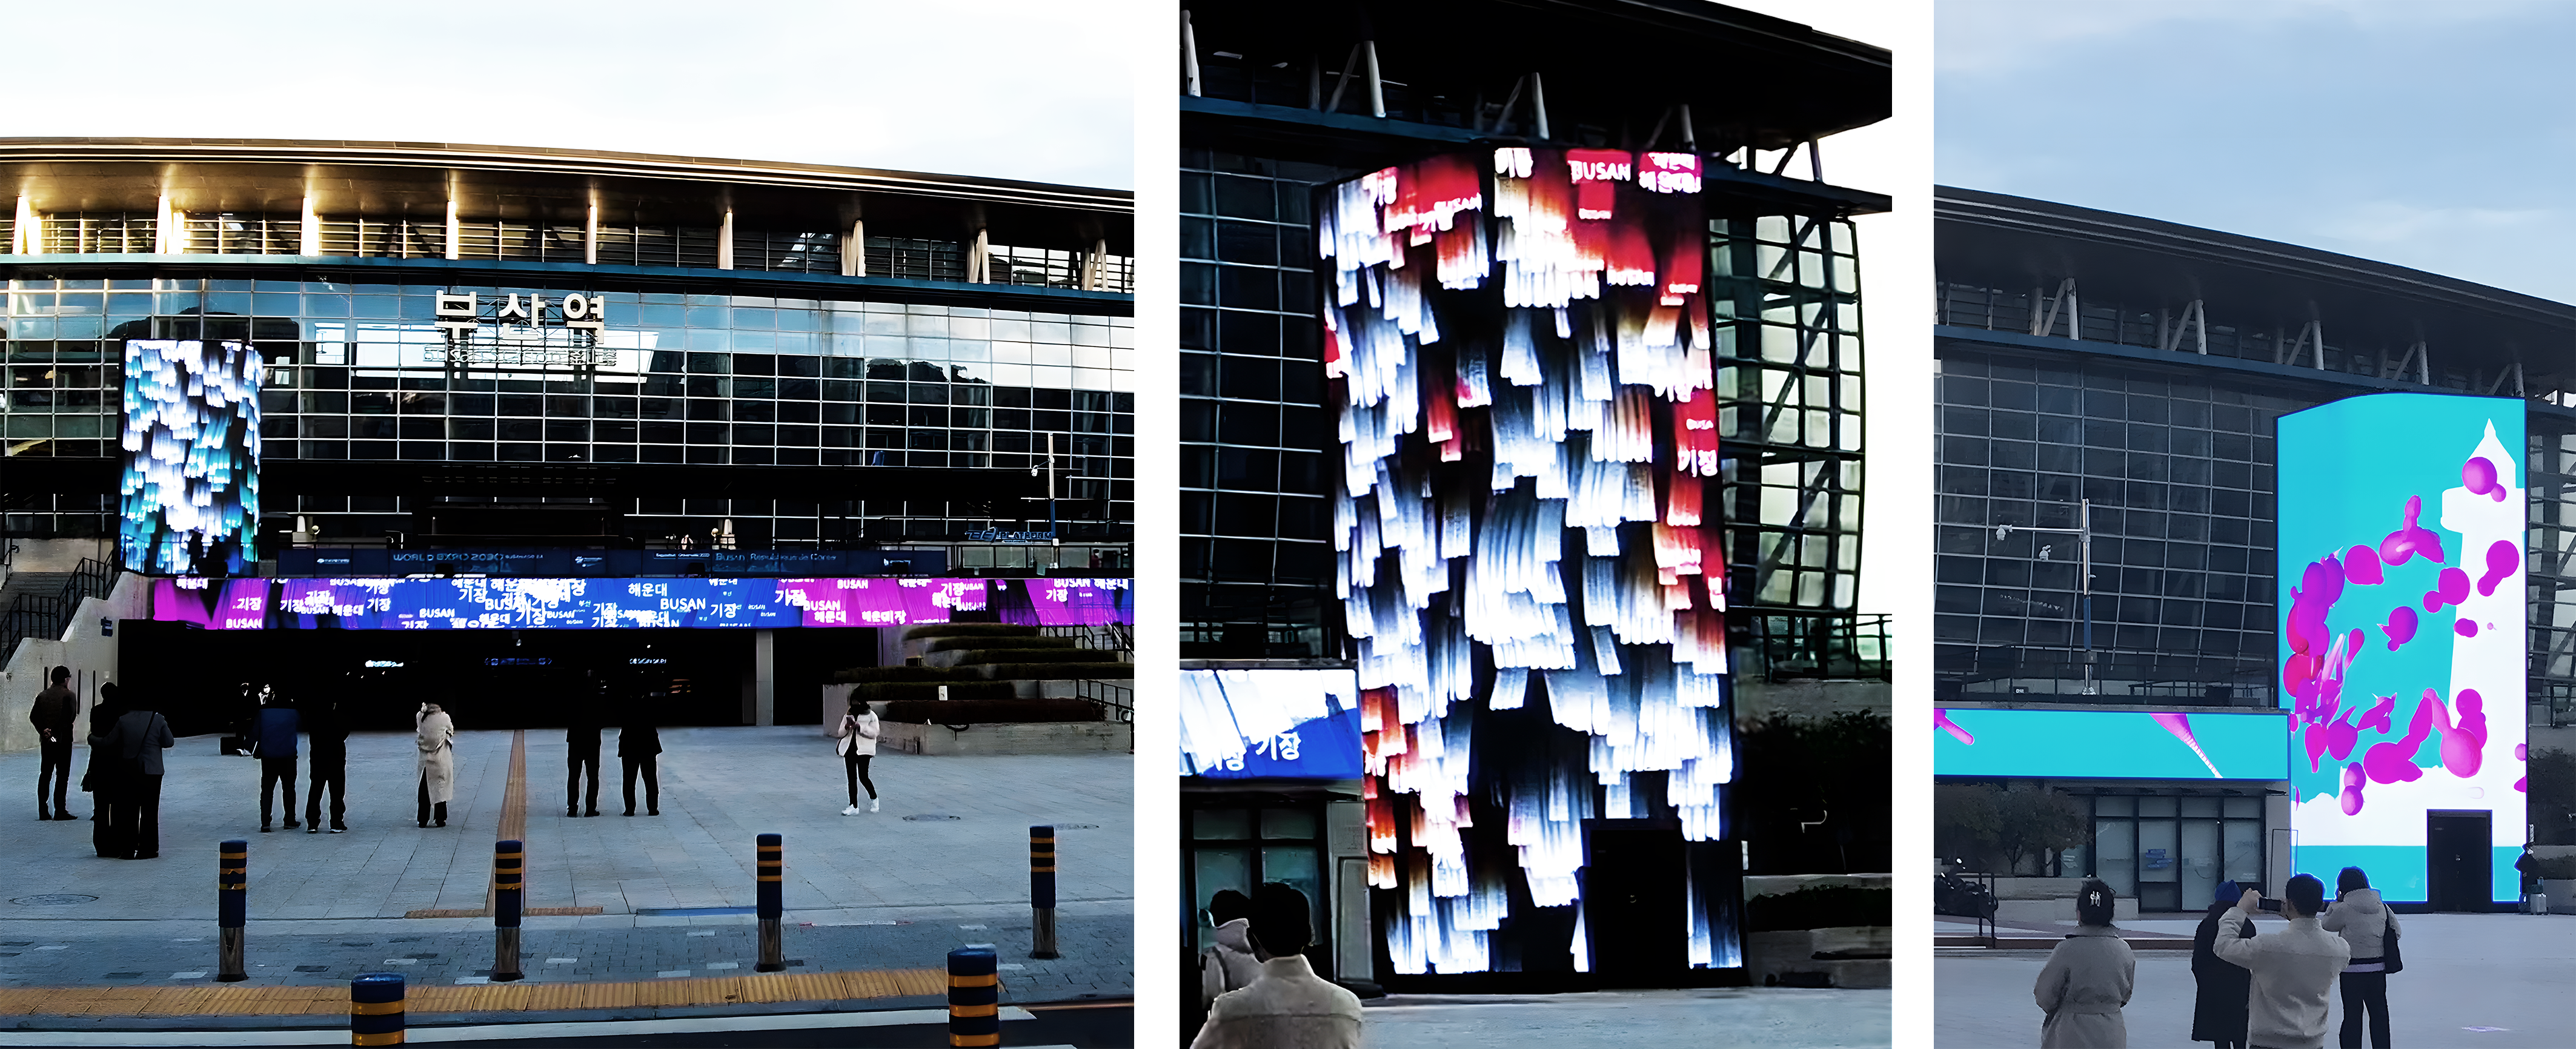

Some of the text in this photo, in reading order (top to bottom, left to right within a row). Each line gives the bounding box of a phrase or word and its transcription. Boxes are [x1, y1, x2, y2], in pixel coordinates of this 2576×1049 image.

[1571, 160, 1631, 181] BUSAN
[434, 290, 605, 344] 부산역
[393, 552, 434, 561] WORLD
[470, 552, 504, 561] 2030
[628, 583, 667, 597] 해운대
[837, 580, 868, 589] BUSAN
[941, 582, 964, 597] 기장
[458, 585, 488, 603] 기장
[1046, 588, 1068, 603] 기장
[236, 597, 262, 611] 기장
[280, 599, 304, 612] 기장
[366, 597, 391, 612] 기장
[660, 598, 706, 610] BUSAN
[711, 603, 736, 618] 기장
[803, 600, 840, 611] BUSAN
[420, 608, 455, 618] BUSAN
[814, 611, 846, 623] 해운대
[226, 618, 262, 629] BUSAN
[1256, 732, 1302, 761] 기장
